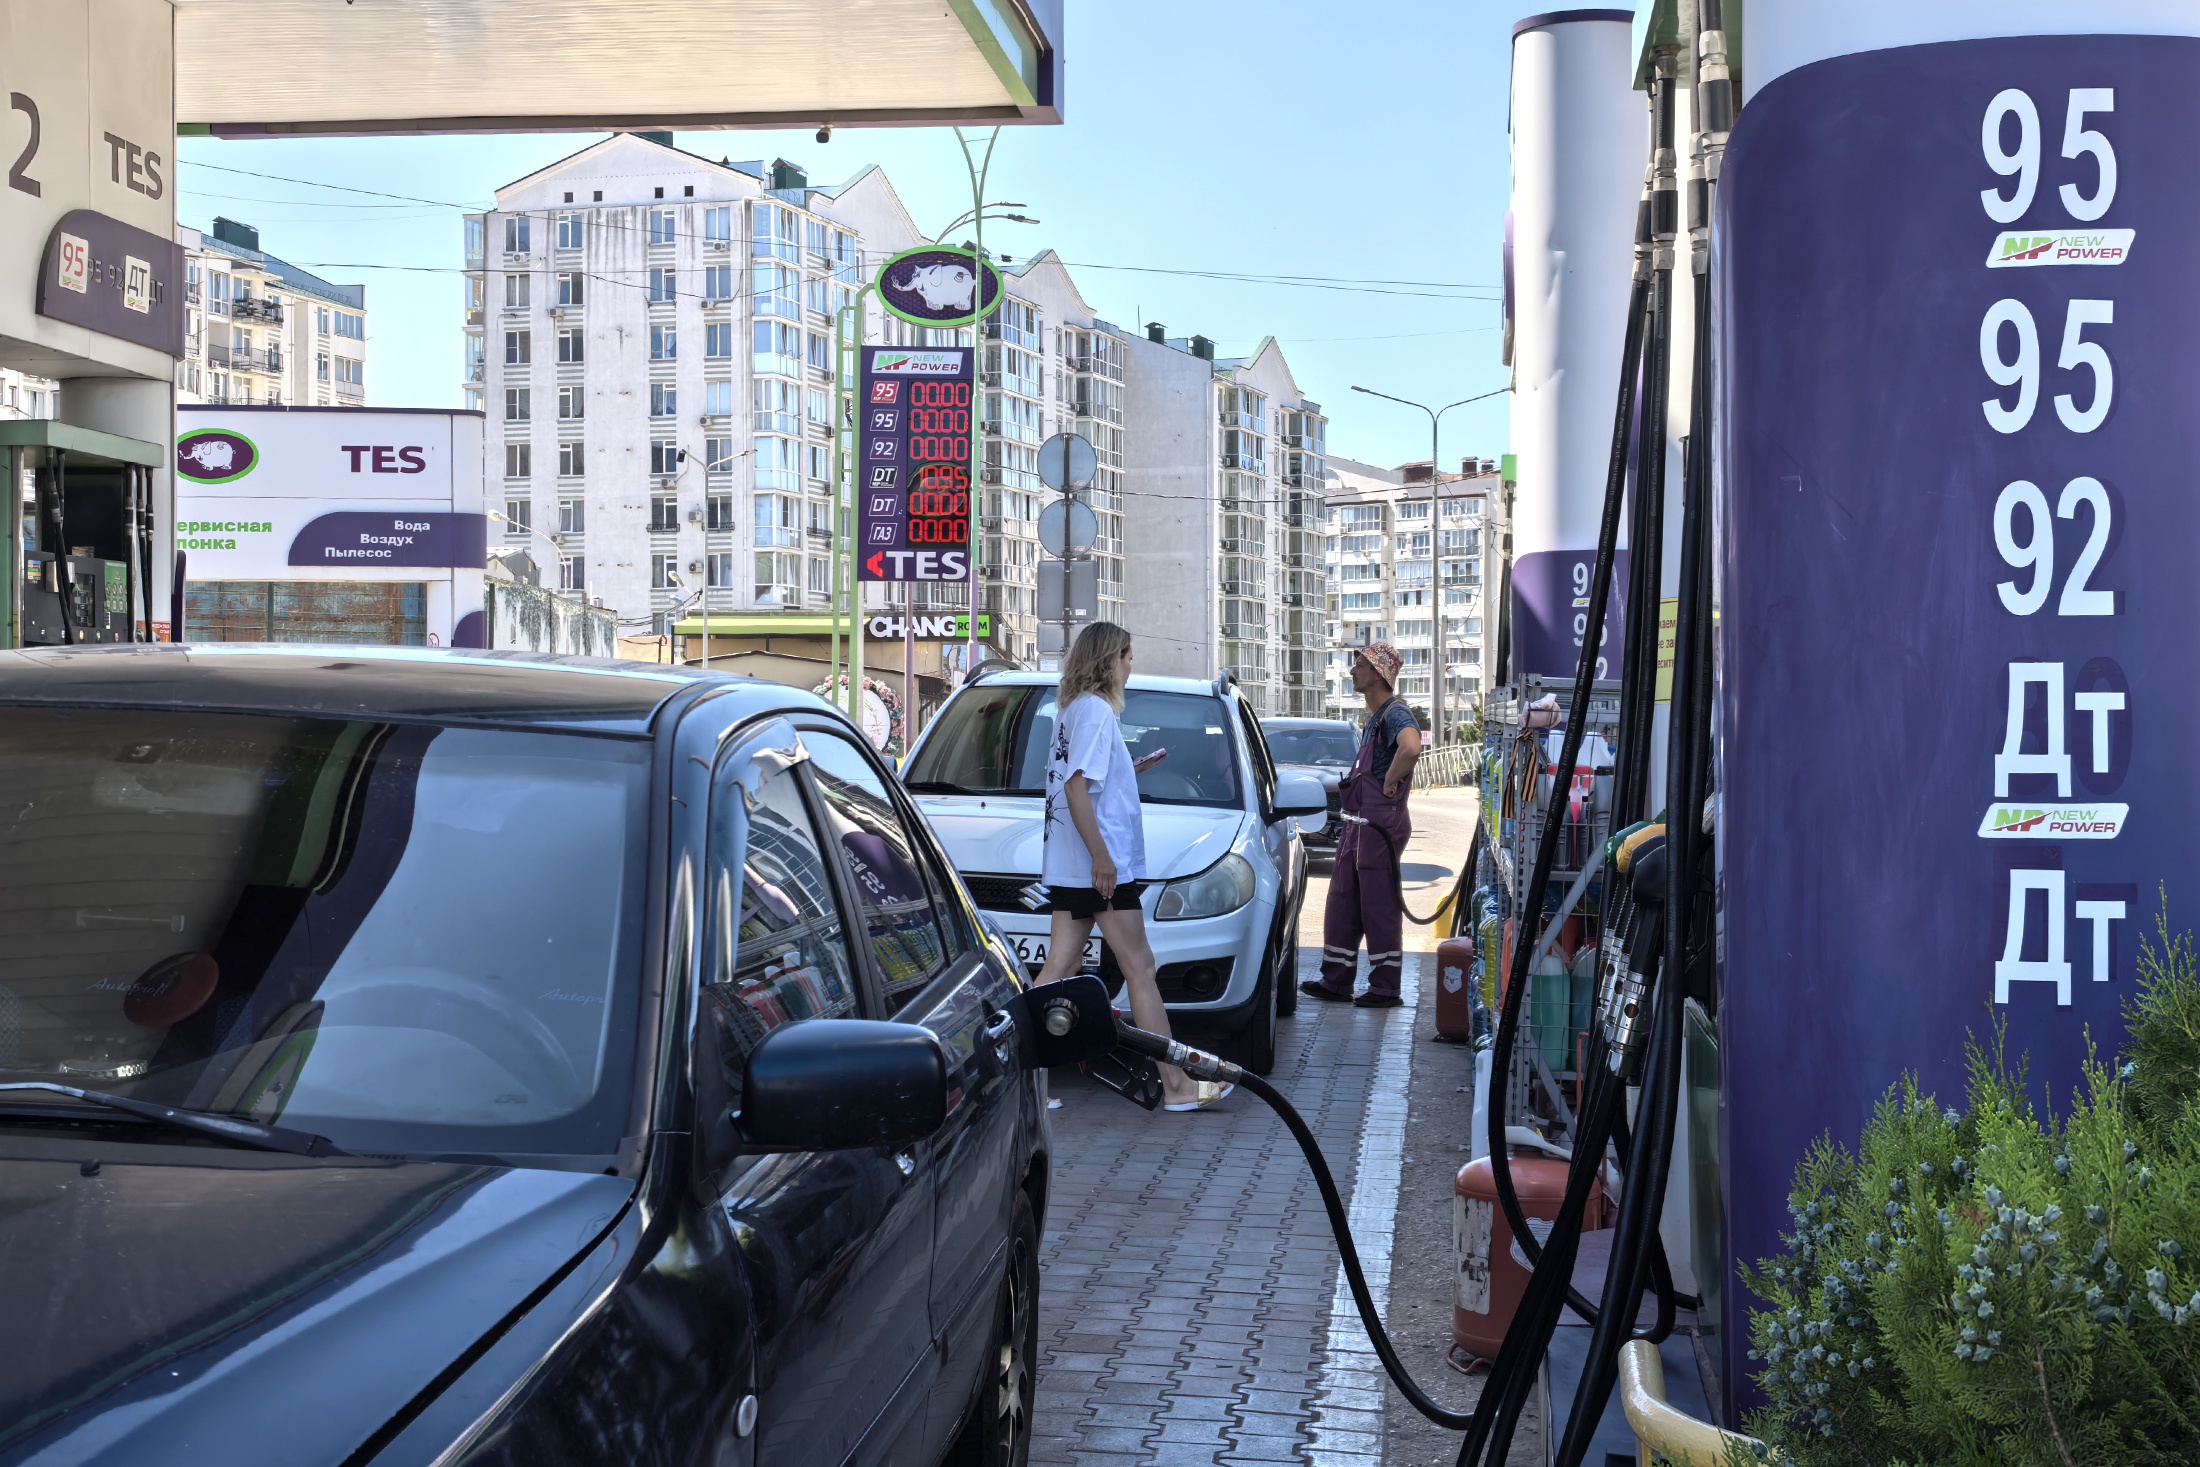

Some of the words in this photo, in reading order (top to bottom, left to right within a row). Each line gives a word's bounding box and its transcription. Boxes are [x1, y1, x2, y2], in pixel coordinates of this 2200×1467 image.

[9, 92, 41, 198] 2
[1980, 88, 2117, 223] 95
[104, 131, 163, 200] TES
[2060, 236, 2104, 246] NEW
[63, 241, 84, 277] 95
[2057, 248, 2122, 259] POWER
[912, 354, 944, 362] NEW
[911, 363, 959, 371] POWER
[1979, 298, 2114, 433] 95
[875, 383, 895, 397] 95
[874, 413, 894, 428] 95
[874, 441, 894, 455] 92
[341, 445, 426, 474] TES
[873, 468, 896, 482] DT
[872, 498, 895, 512] DT
[177, 520, 272, 535] ервисная
[394, 520, 431, 532] Вода
[873, 526, 892, 540] ГАЗ
[360, 533, 413, 546] Воздух
[1993, 476, 2115, 616] 92
[325, 547, 392, 559] Пылесос
[886, 551, 967, 579] TES
[2052, 810, 2098, 820] NEW
[2049, 822, 2116, 833] POWER
